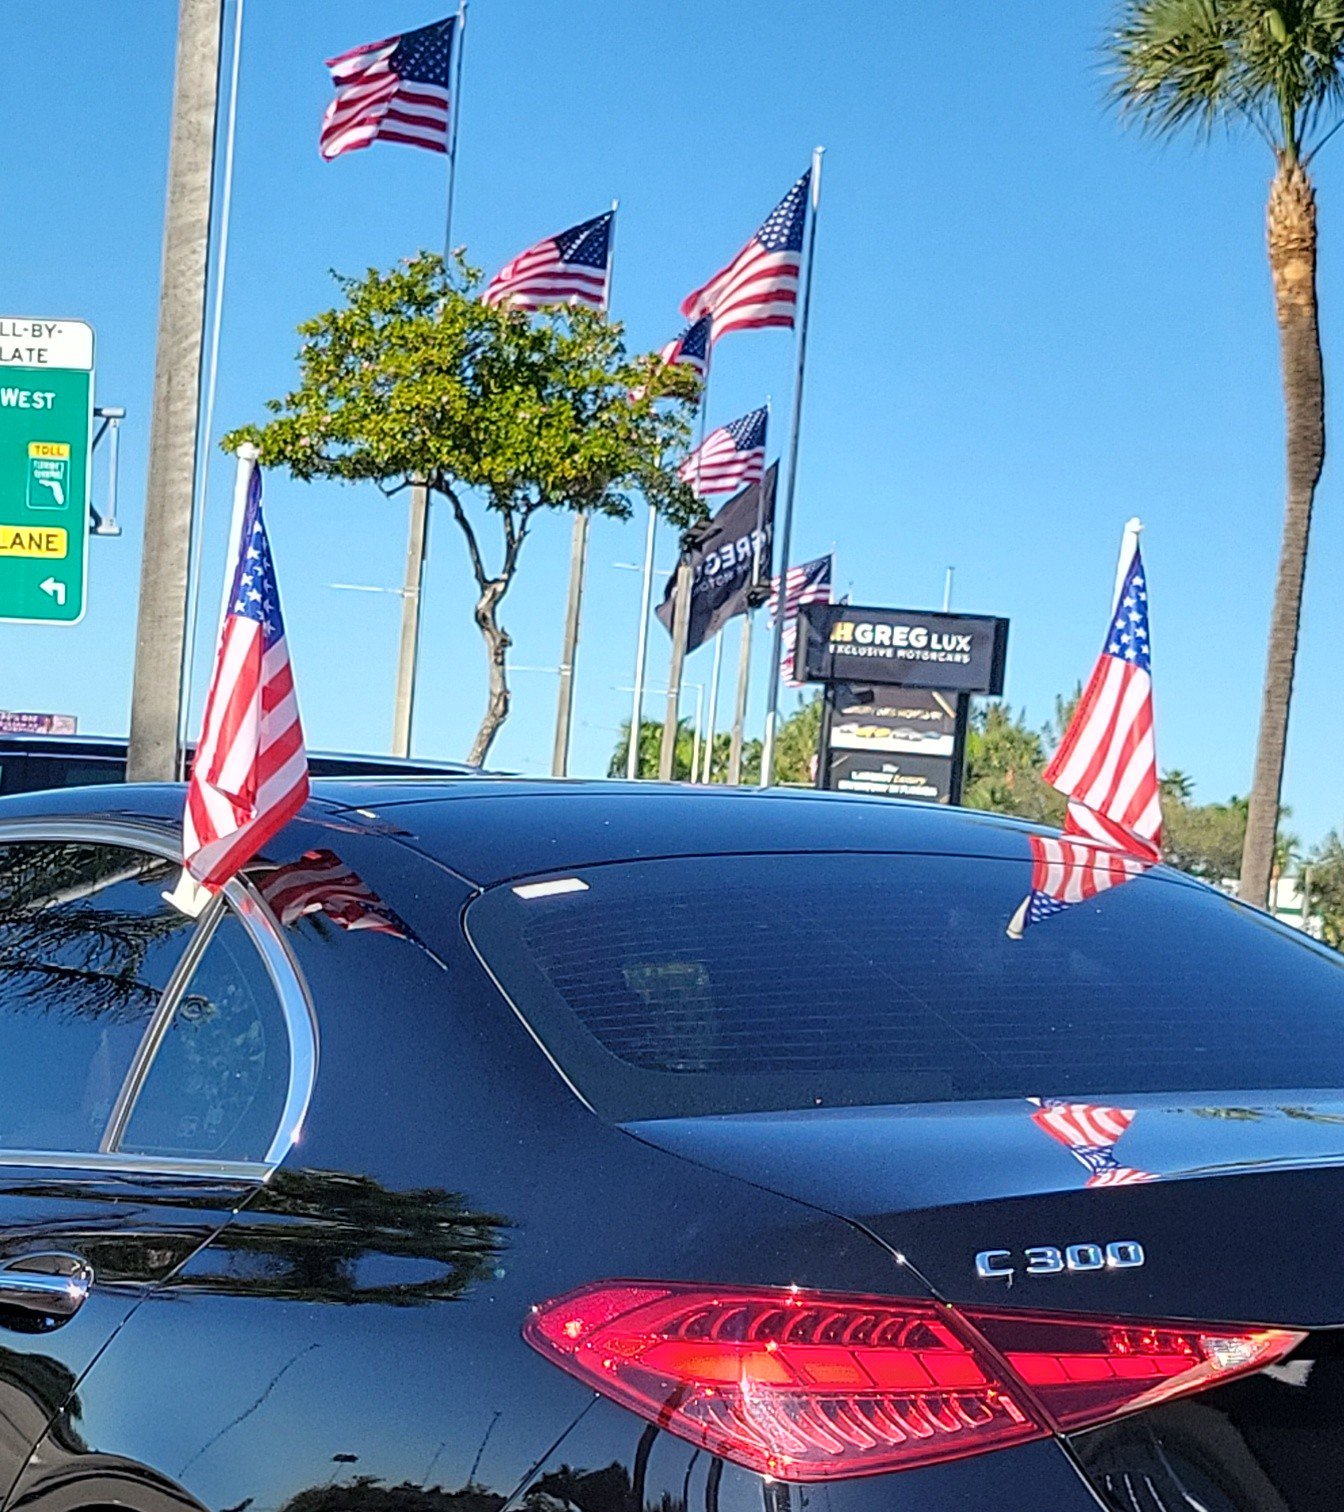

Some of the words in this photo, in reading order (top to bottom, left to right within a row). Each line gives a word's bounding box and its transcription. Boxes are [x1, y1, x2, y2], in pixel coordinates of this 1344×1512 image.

[0, 387, 57, 410] WEST
[34, 444, 65, 457] TOLL
[896, 649, 971, 665] MOTORCARS
[975, 1249, 1015, 1278] C
[1024, 1240, 1146, 1274] 300
